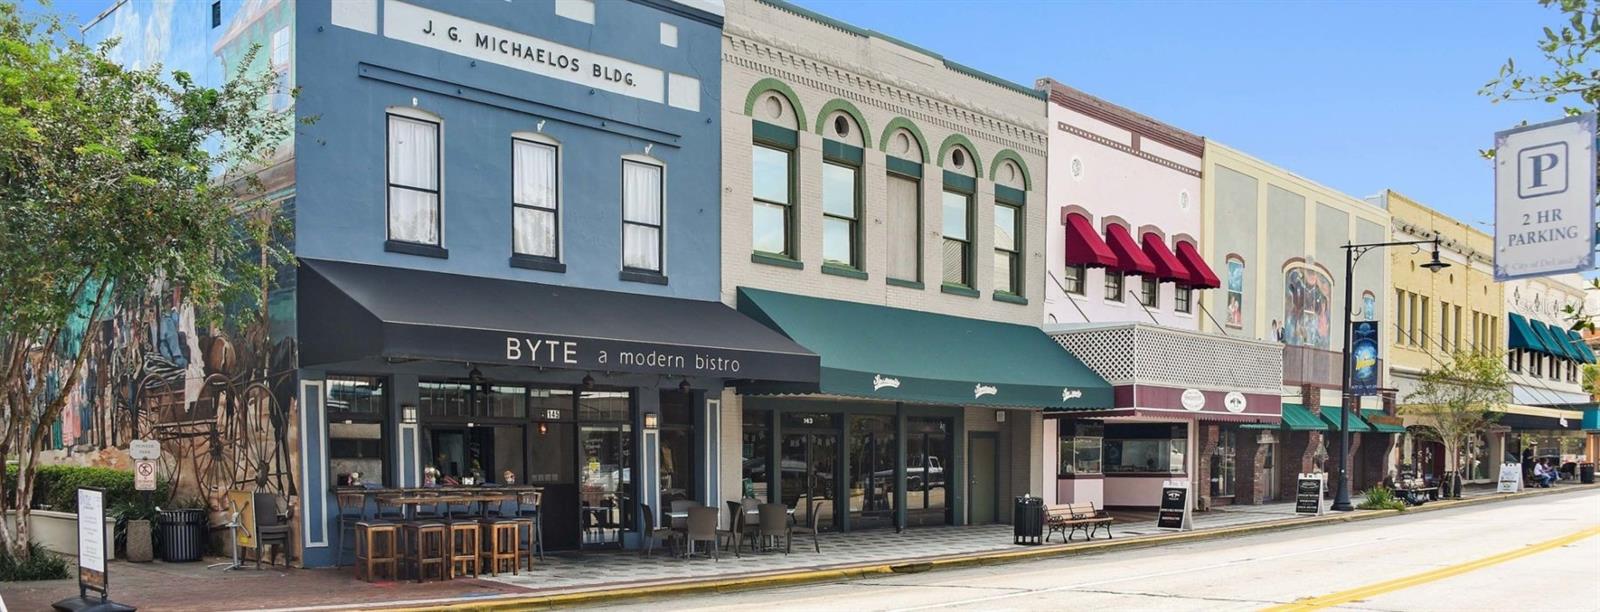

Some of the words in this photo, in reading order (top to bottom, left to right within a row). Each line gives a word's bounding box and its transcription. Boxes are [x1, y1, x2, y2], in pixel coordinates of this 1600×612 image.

[423, 20, 436, 36] J.
[448, 26, 462, 42] G.
[475, 33, 581, 72] MICHAELOS
[592, 63, 637, 87] BLDG.
[1527, 152, 1559, 190] P
[1522, 213, 1531, 226] 2
[1537, 208, 1562, 224] HR
[1509, 226, 1578, 247] PARKING
[506, 337, 578, 364] BYTE
[598, 350, 608, 364] a
[620, 350, 685, 369] modern
[695, 354, 741, 372] bistro
